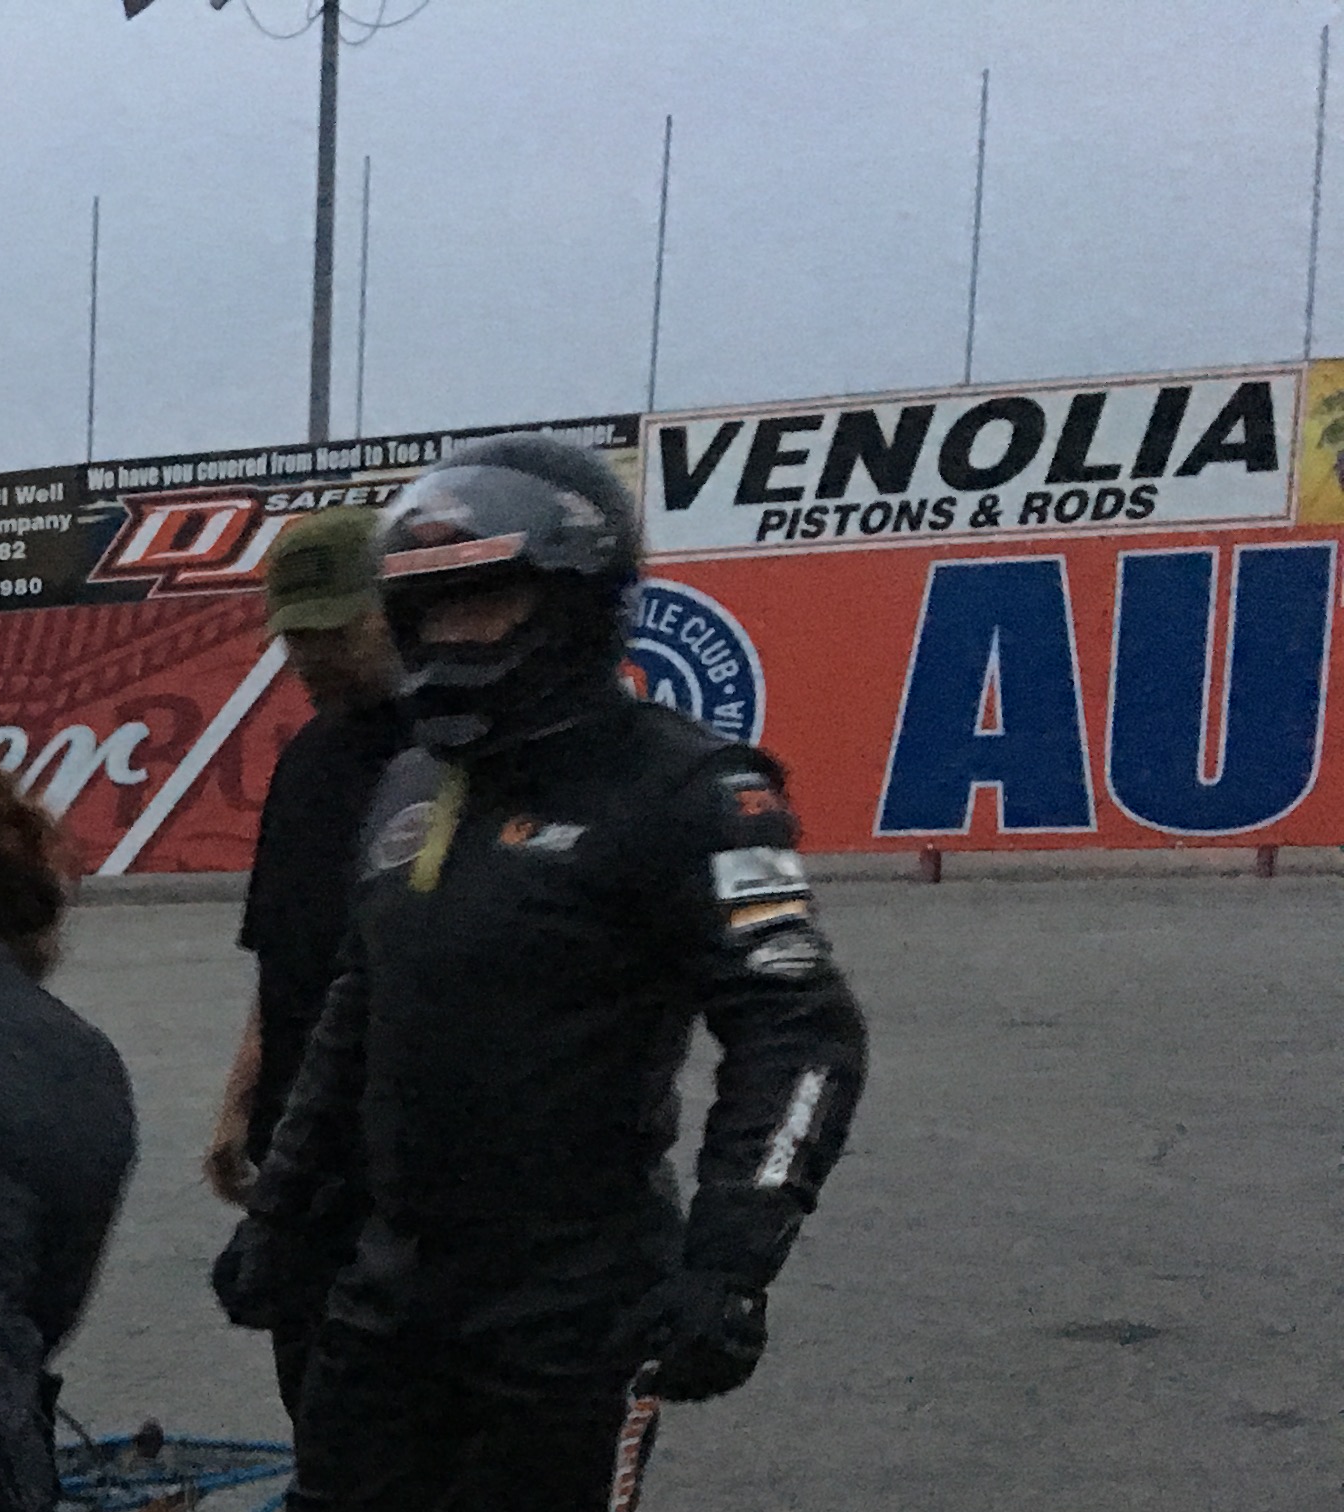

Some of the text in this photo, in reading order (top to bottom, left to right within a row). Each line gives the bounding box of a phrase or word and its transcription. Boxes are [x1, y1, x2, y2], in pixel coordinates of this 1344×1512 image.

[87, 468, 115, 490] We
[118, 465, 159, 489] have
[162, 462, 195, 486] you
[197, 452, 267, 481] covered
[270, 450, 313, 475] from
[316, 446, 361, 471] Head
[364, 444, 383, 465] to
[387, 441, 419, 463] Toe
[658, 380, 1280, 512] VENOLIA
[14, 483, 64, 504] Well
[264, 484, 402, 511] SAFET
[756, 484, 1157, 543] PISTONS & RODS
[680, 615, 741, 684] CLUB
[873, 540, 1344, 837] AU
